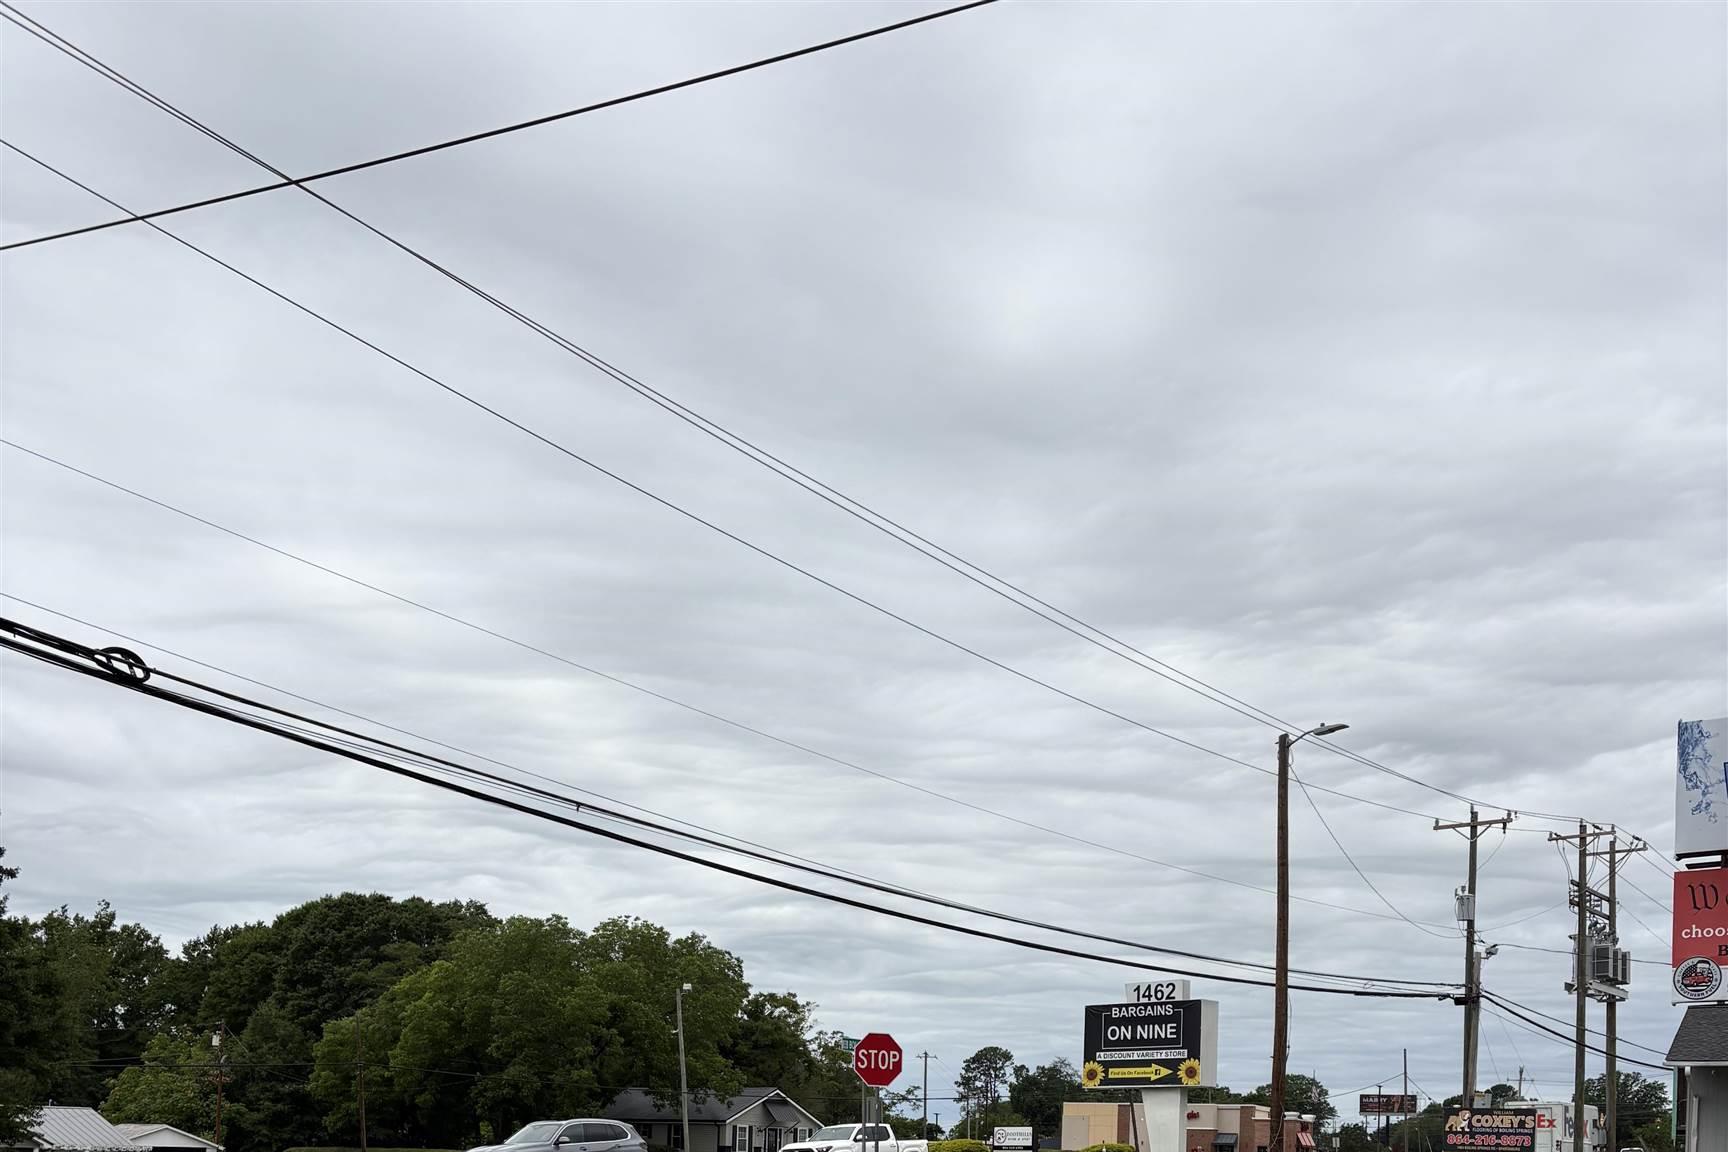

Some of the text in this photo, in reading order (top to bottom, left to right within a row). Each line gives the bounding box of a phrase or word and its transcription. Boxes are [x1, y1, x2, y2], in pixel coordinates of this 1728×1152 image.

[1133, 982, 1176, 1002] 1462
[1111, 1004, 1174, 1018] BARGAINS
[1107, 1023, 1177, 1041] ON NINE
[857, 1049, 900, 1070] STOP
[1471, 1114, 1535, 1128] COXEY'S
